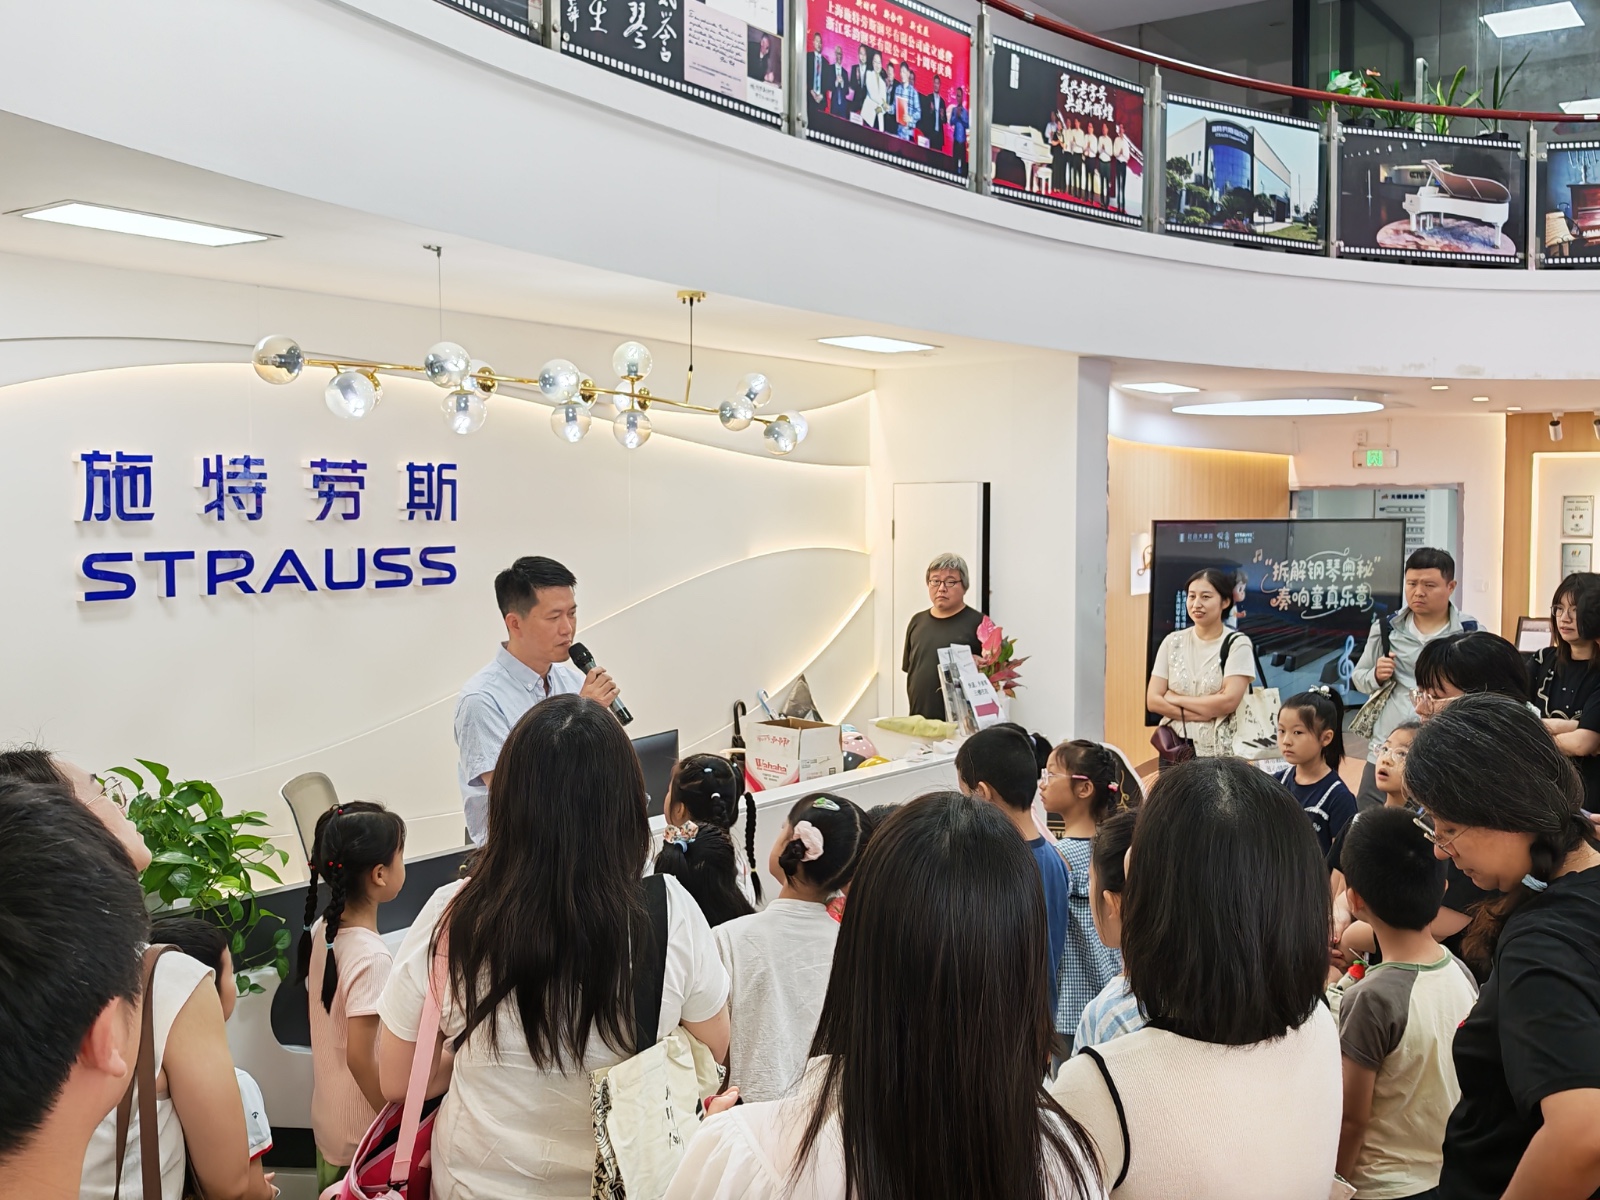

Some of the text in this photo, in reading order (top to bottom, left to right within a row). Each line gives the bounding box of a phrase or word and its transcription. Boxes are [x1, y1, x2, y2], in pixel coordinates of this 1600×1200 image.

[80, 449, 458, 522] 施特劳斯
[80, 545, 458, 602] STRAUSS
[1276, 584, 1369, 611] 奏响童真乐章
[755, 757, 787, 773] Wahaha
